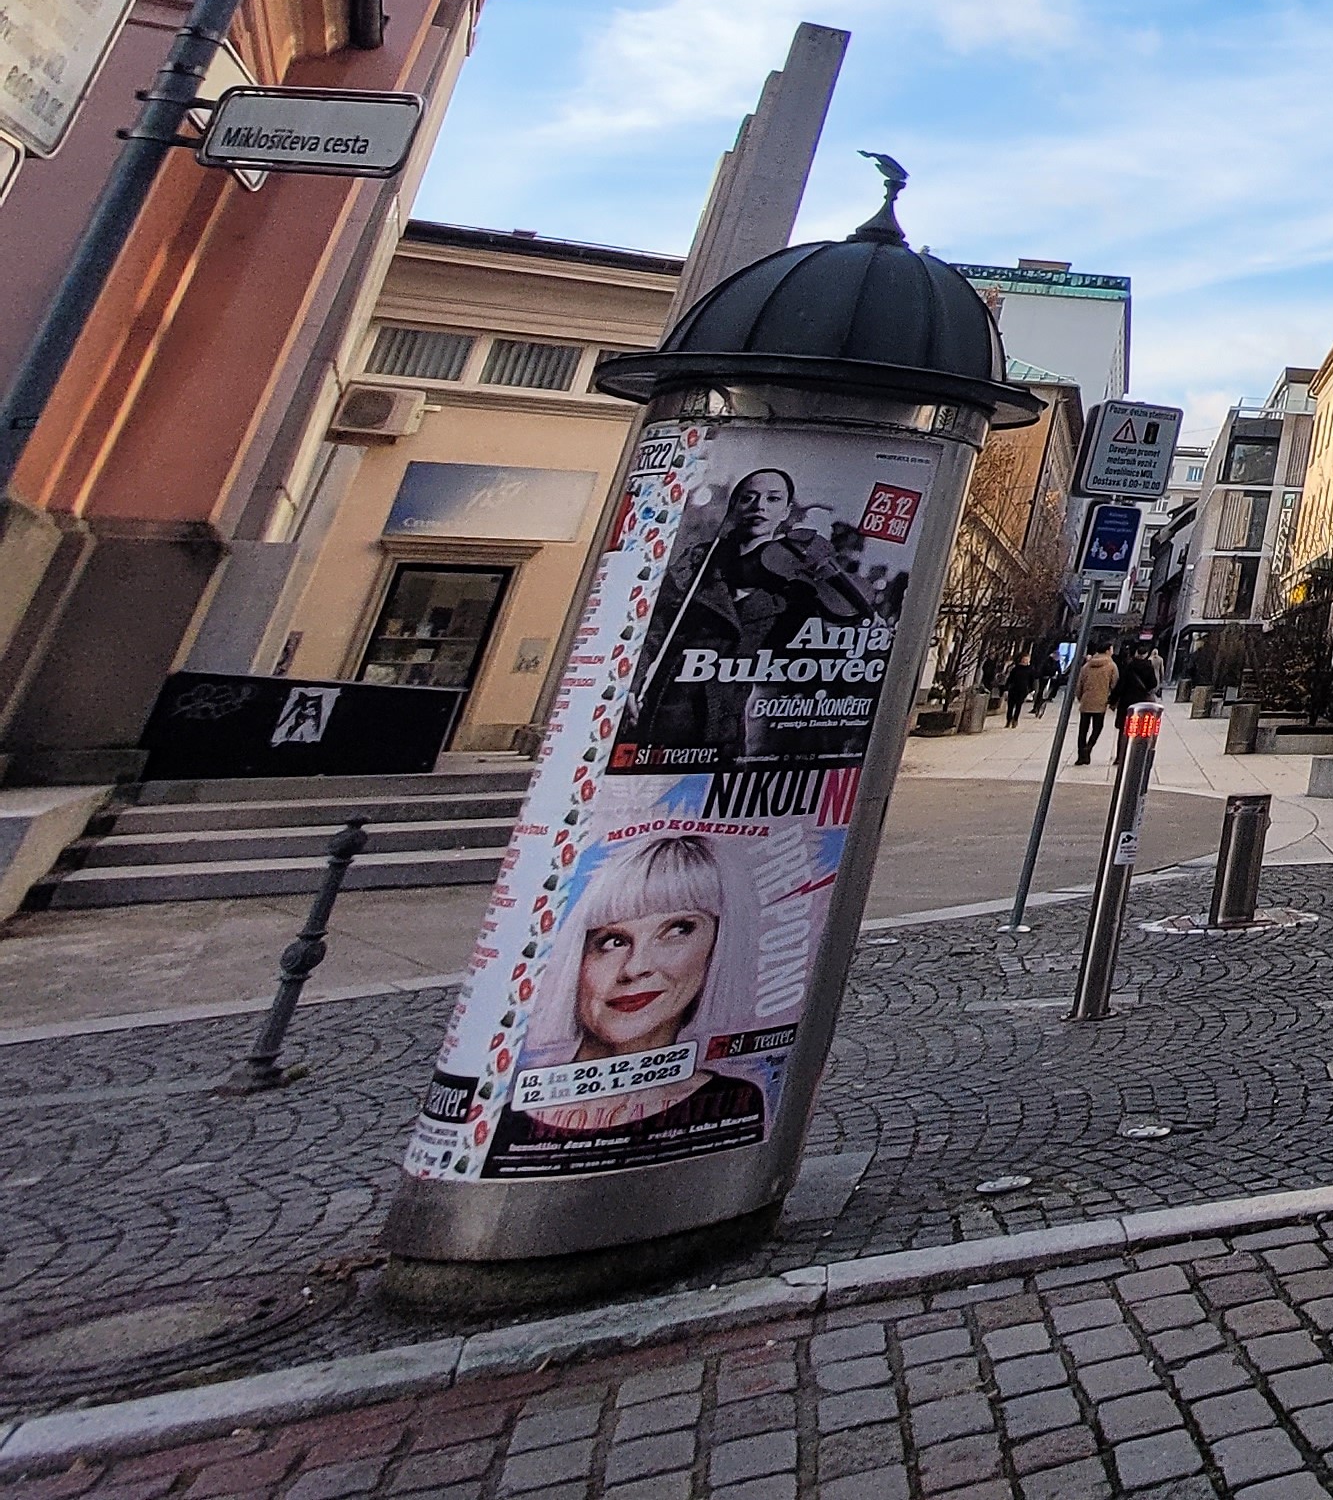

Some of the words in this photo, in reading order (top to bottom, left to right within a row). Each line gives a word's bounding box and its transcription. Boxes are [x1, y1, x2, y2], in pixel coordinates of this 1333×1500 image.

[221, 126, 320, 153] Miklošičeva
[323, 134, 369, 155] cesta
[863, 513, 885, 532] OB
[887, 517, 909, 538] 19H
[786, 617, 892, 659] Anja
[674, 649, 885, 683] Bukovec
[750, 694, 814, 718] BOŽIČNI
[815, 697, 873, 716] KONCERT
[816, 766, 861, 827] NI
[607, 819, 770, 843] MONOKOMEDIJA
[521, 1075, 542, 1089] 13.
[574, 1066, 603, 1080] 20.
[609, 1061, 634, 1075] 12.
[641, 1048, 690, 1068] 2022
[522, 1090, 544, 1104] 12.
[576, 1081, 605, 1096] 20.
[611, 1077, 625, 1090] 1.
[630, 1064, 681, 1086] 2023
[529, 1101, 644, 1139] MOJCA
